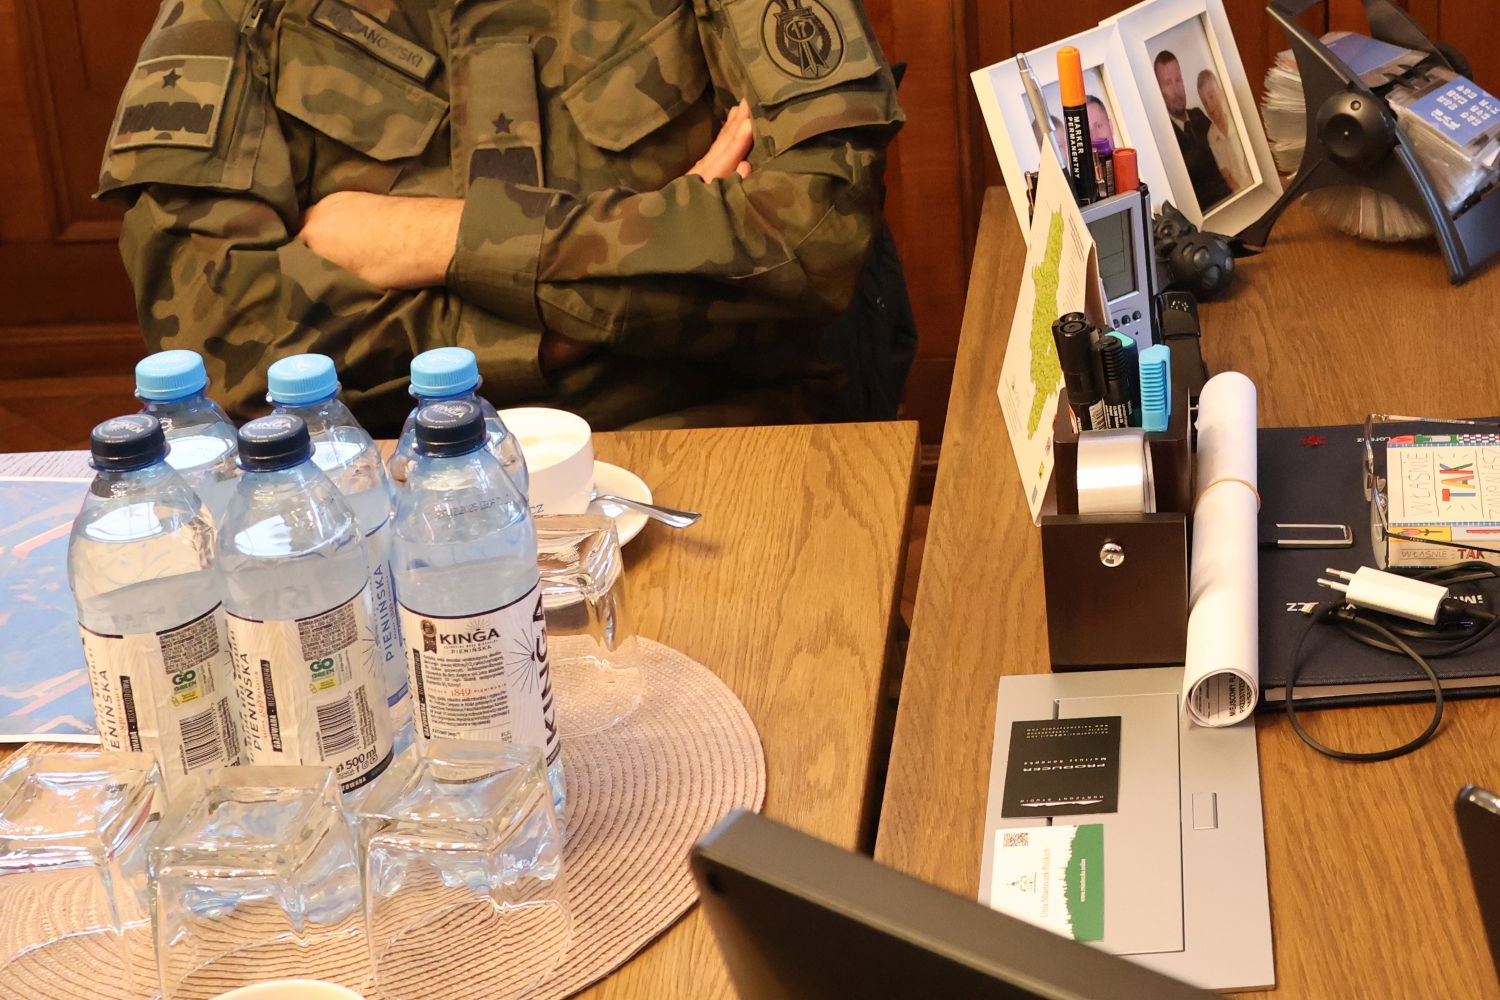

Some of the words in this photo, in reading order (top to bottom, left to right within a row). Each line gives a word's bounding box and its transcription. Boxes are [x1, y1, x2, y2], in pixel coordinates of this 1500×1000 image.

[1073, 116, 1084, 154] MARKER
[1067, 116, 1080, 179] PERMANENTNY
[248, 418, 292, 430] KINGA
[1439, 462, 1477, 502] TAK
[1457, 548, 1486, 560] TAK
[440, 627, 501, 646] KINGA
[309, 657, 334, 673] GO
[172, 669, 196, 685] GO
[311, 668, 335, 679] GREEN
[174, 681, 197, 691] GREEN
[345, 754, 366, 772] 500
[366, 745, 377, 763] ml
[1023, 763, 1106, 772] PRODUCER
